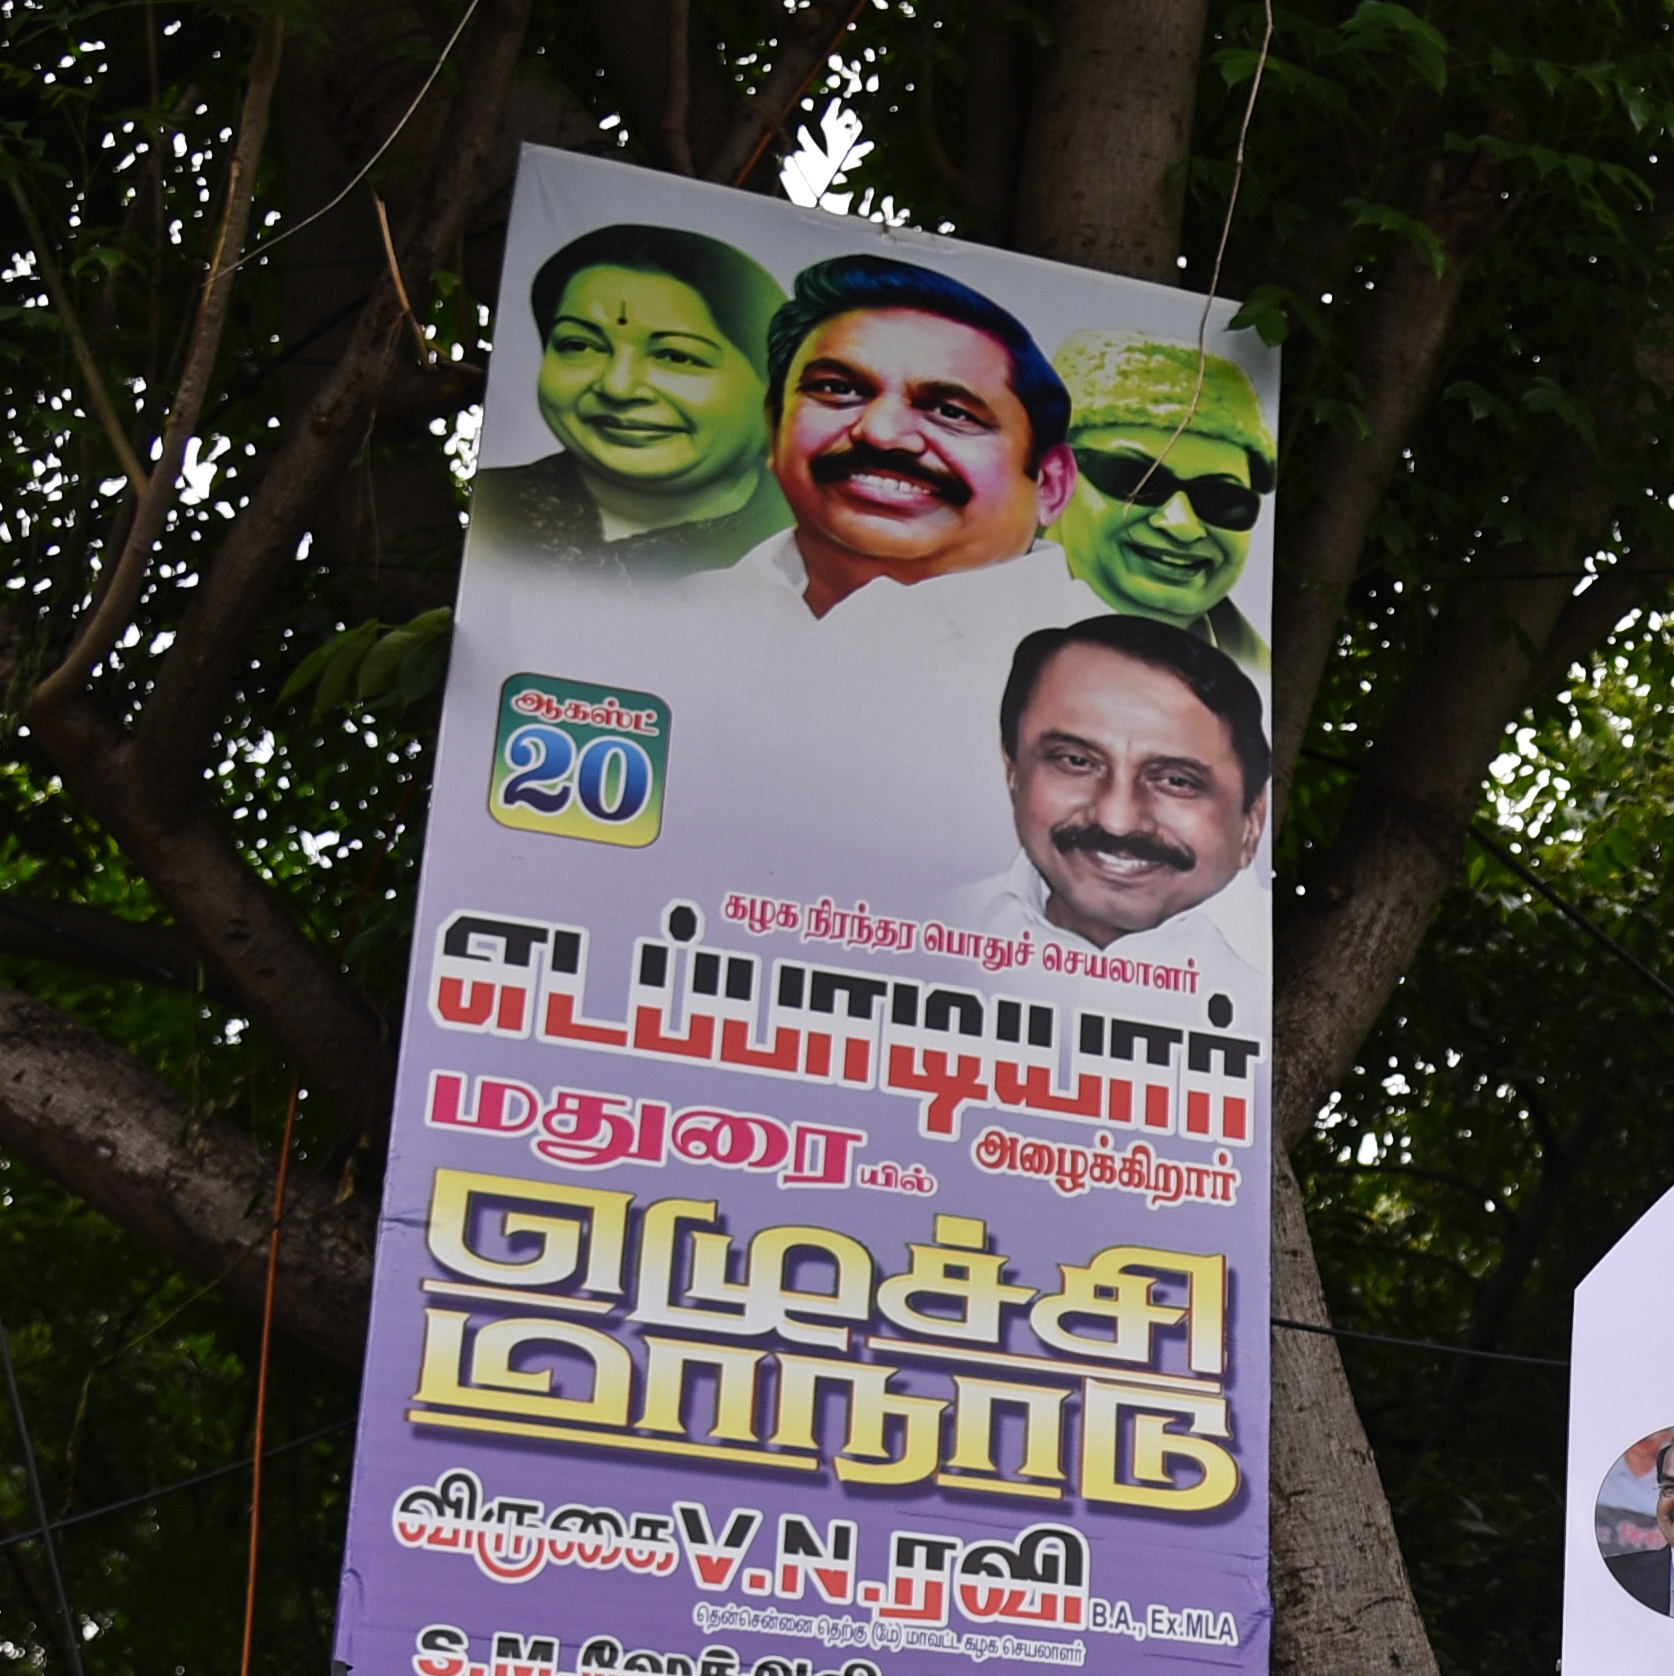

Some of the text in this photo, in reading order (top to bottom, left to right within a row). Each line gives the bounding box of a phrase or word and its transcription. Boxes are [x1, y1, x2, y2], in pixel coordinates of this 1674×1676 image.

[511, 687, 658, 737] ஆகஸ்ட்
[500, 723, 654, 824] 20
[724, 893, 1200, 995] கழக நிரந்தர பொதுச் செயலாளர்
[435, 902, 1260, 1141] எடப்பாடியார்
[977, 1127, 1236, 1206] அழைக்கிறார்
[422, 1168, 1228, 1395] எழுச்சி
[408, 1307, 1239, 1510] மாநாடு
[906, 1630, 961, 1650] மாவட்ட
[965, 1637, 999, 1661] கழக
[1003, 1638, 1083, 1664] செயலாளர்
